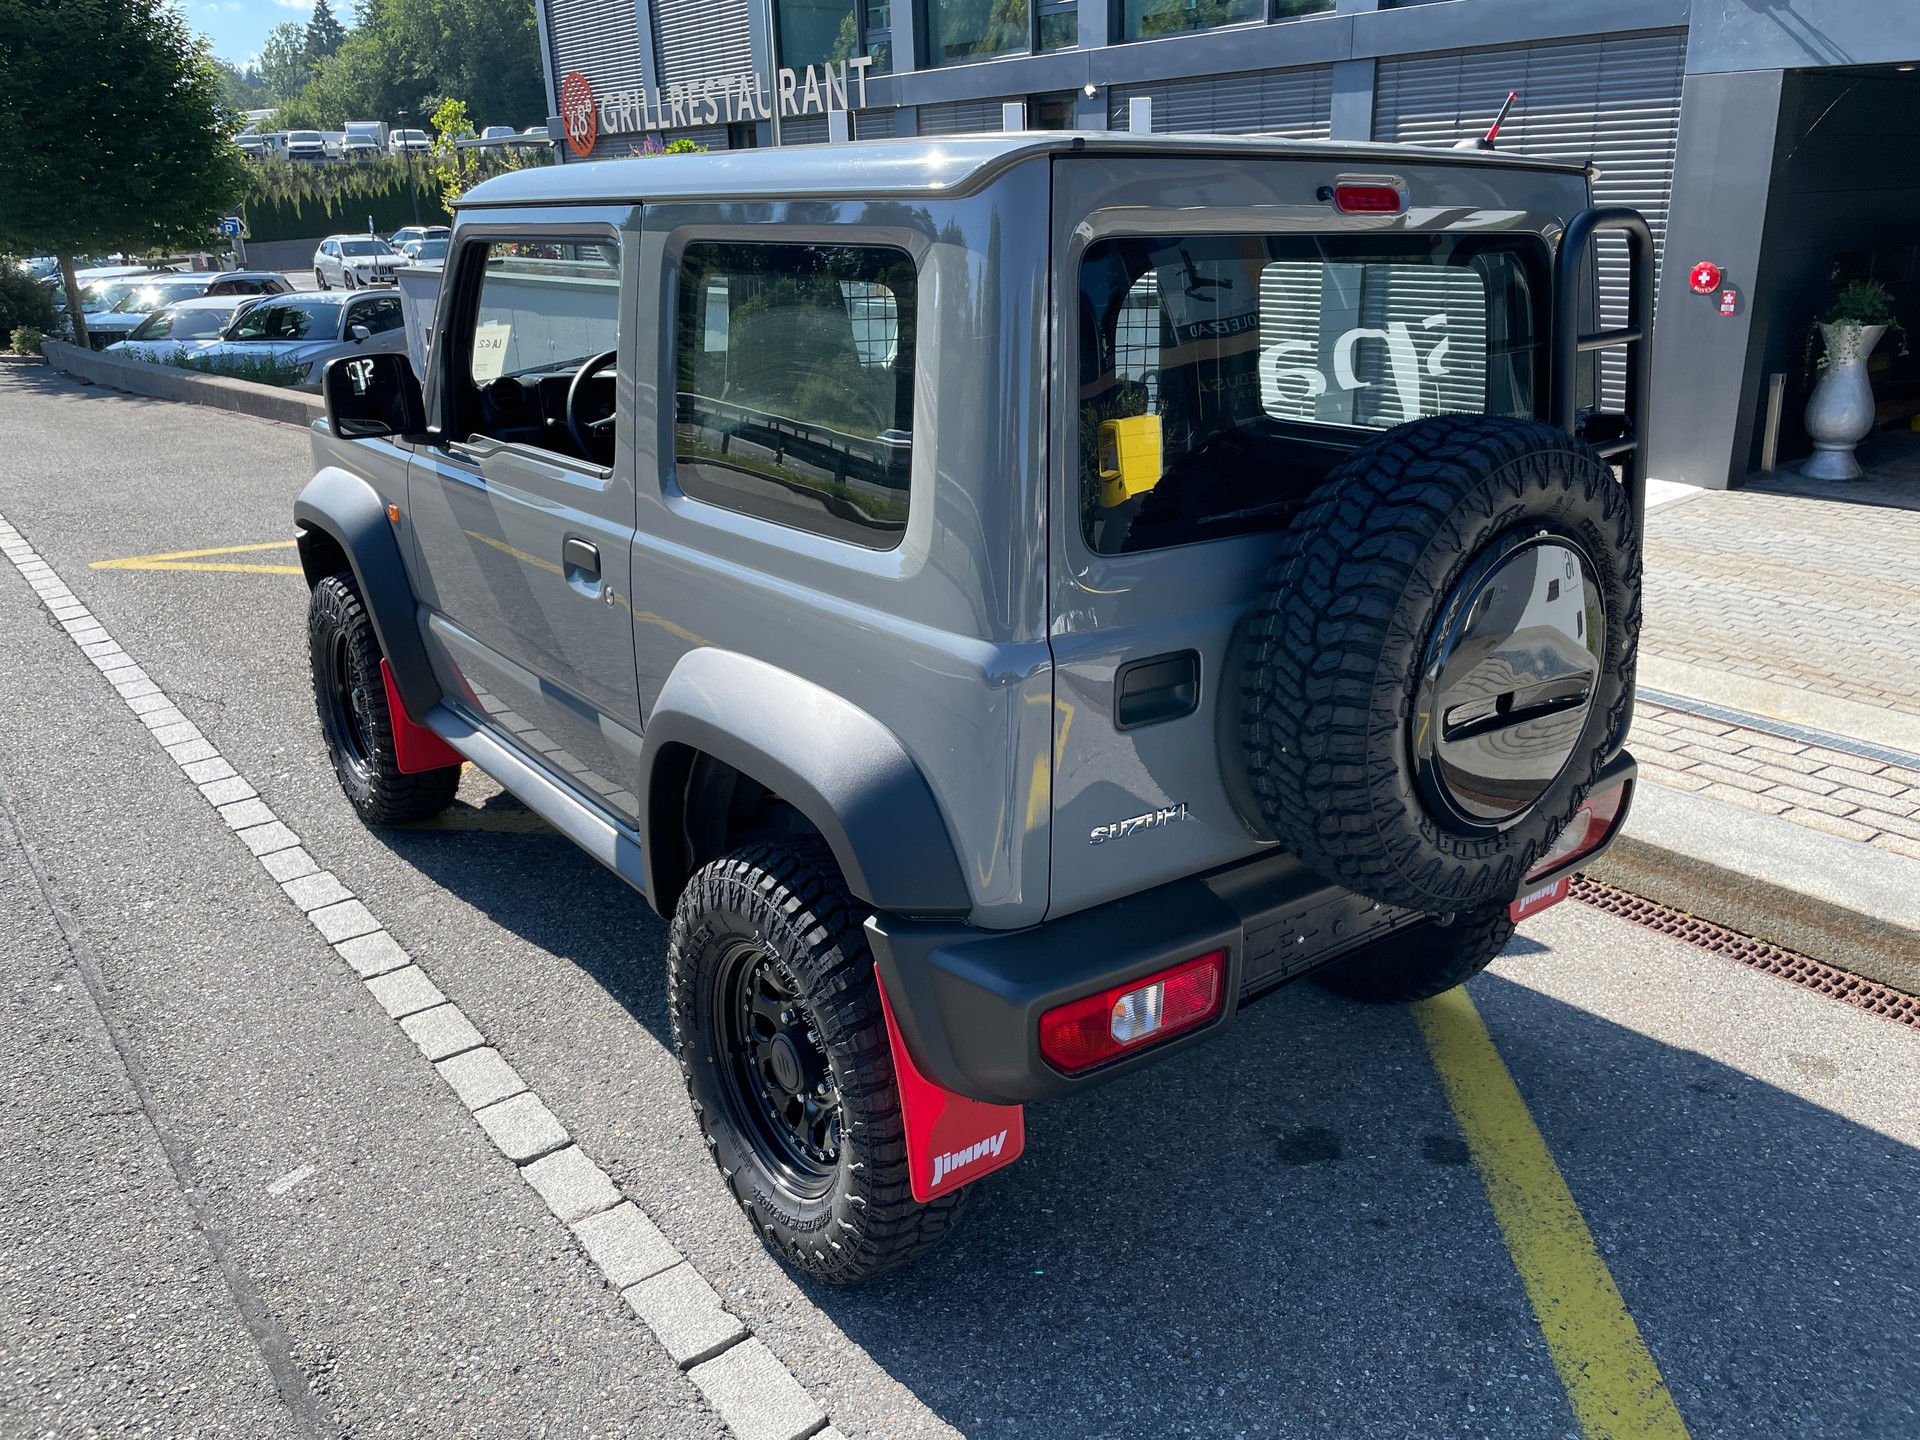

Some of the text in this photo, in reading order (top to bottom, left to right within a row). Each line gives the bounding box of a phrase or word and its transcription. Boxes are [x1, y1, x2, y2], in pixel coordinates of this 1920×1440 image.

[600, 56, 872, 135] GRILLRESTAURANT
[1089, 802, 1188, 845] SUZUKI
[931, 1129, 1008, 1187] Jimny
